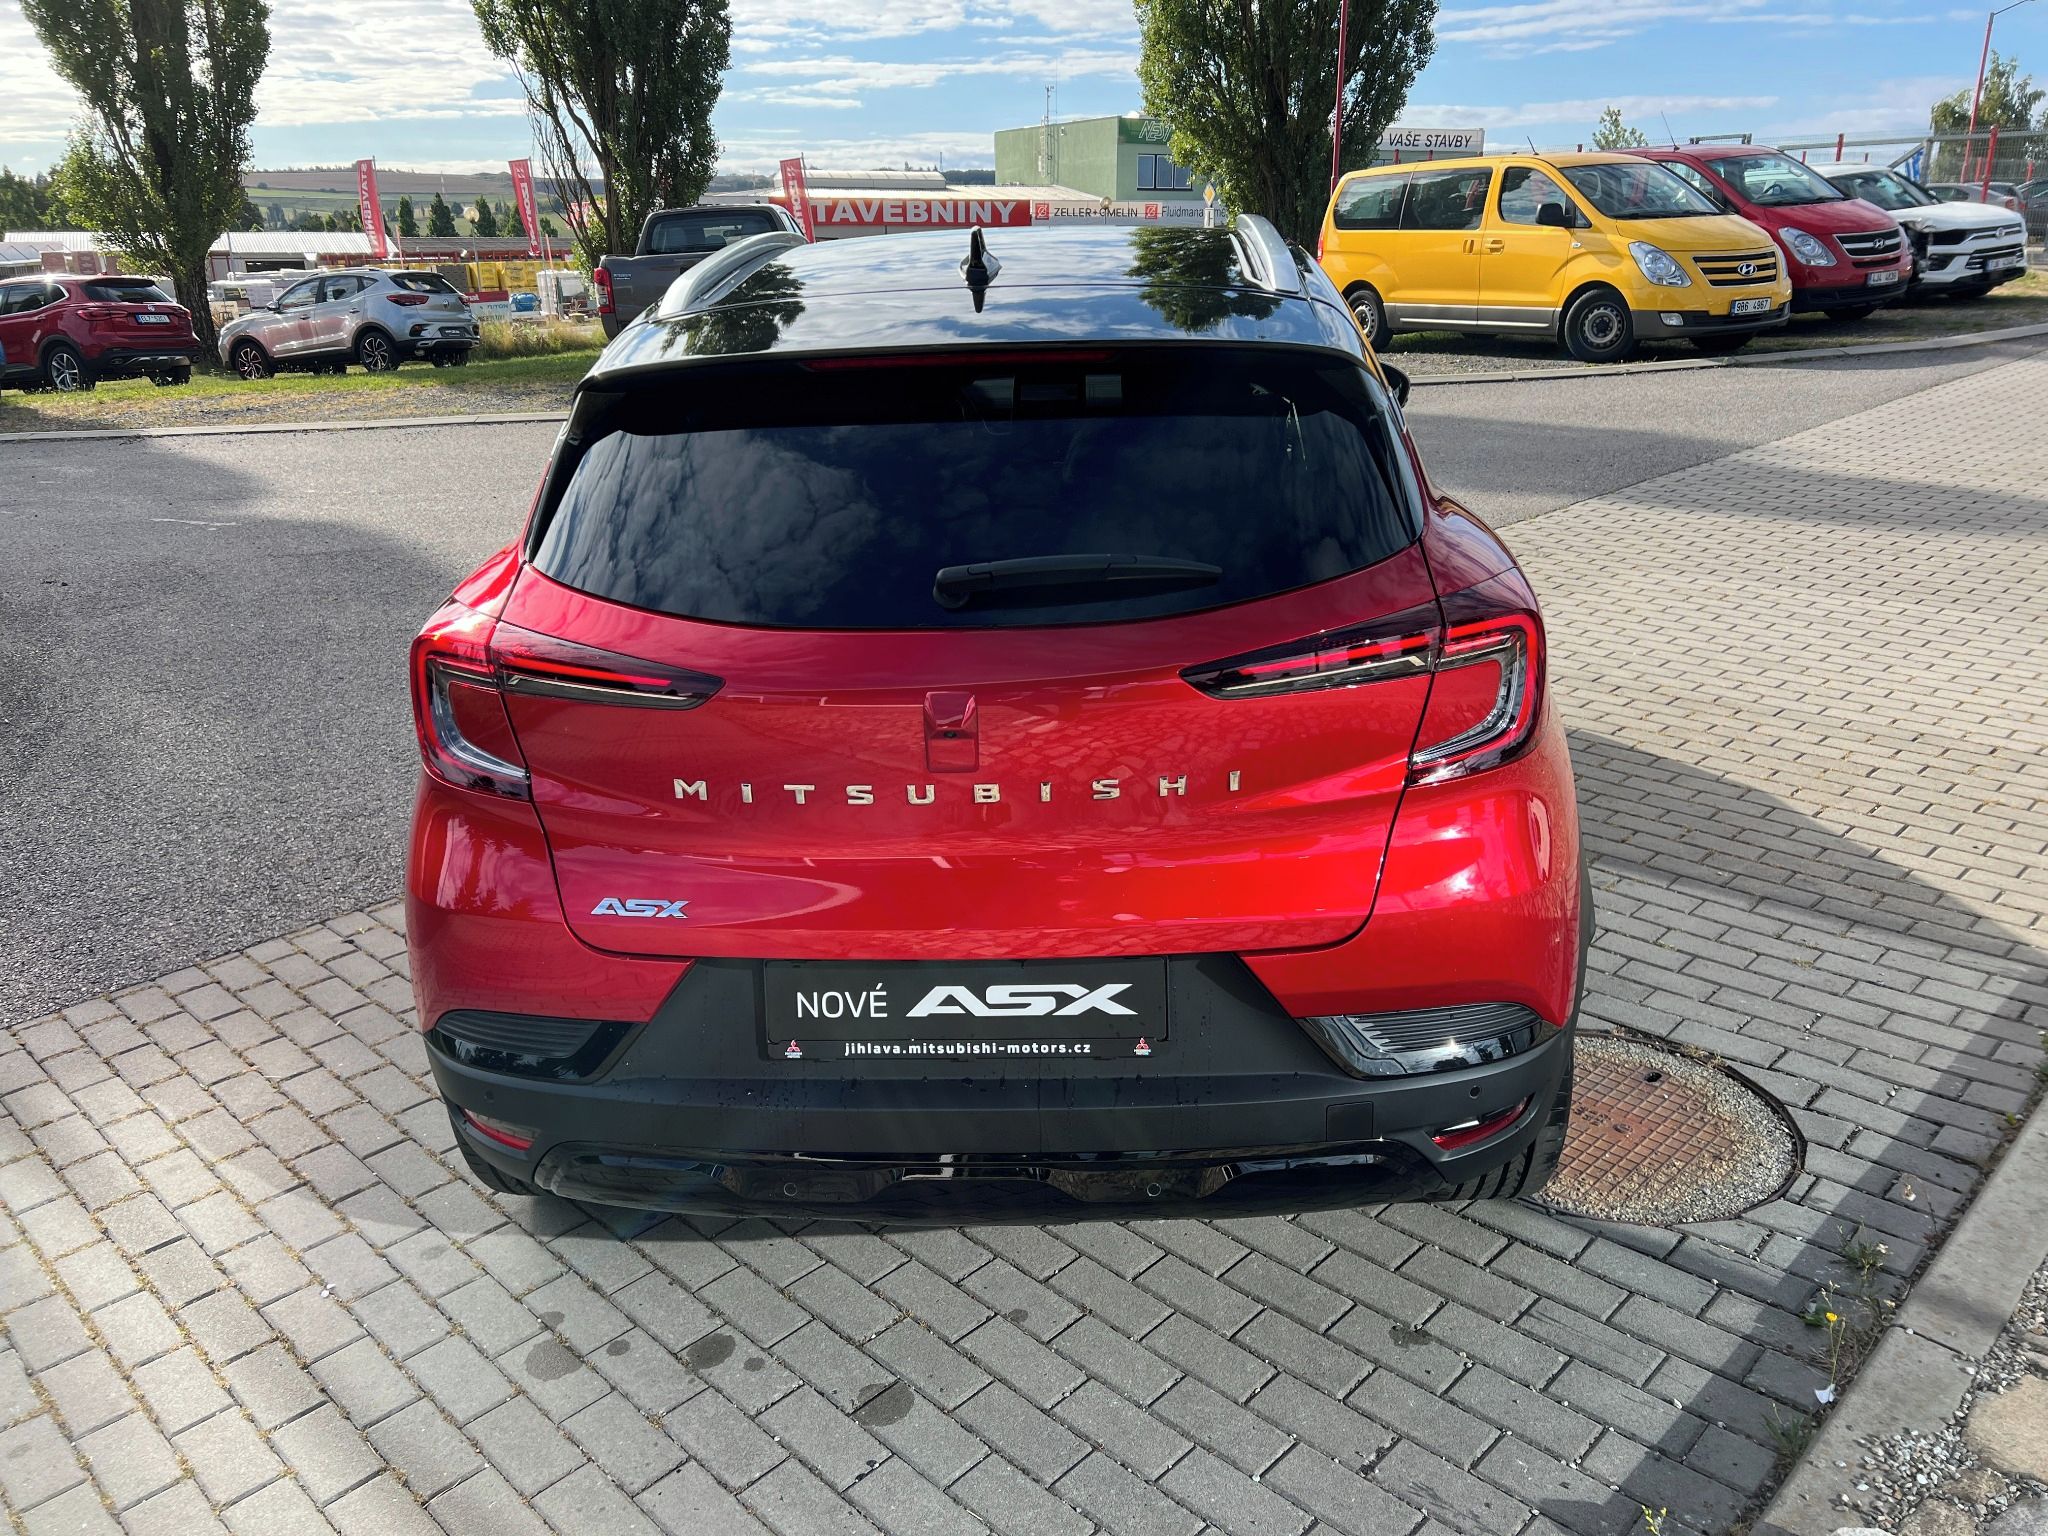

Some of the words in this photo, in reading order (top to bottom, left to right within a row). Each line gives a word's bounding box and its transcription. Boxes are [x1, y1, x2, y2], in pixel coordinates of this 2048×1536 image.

[1389, 131, 1421, 148] VAŠE
[1424, 134, 1473, 148] STAVBY
[809, 199, 1017, 223] TAVEBNINY
[673, 769, 1241, 805] MITSUBISHI
[590, 897, 690, 919] ASX
[797, 982, 888, 1019] NOVÉ
[905, 983, 1139, 1018] ASX
[844, 1041, 1091, 1057] jihlava.mitsubishi-motors.cz
